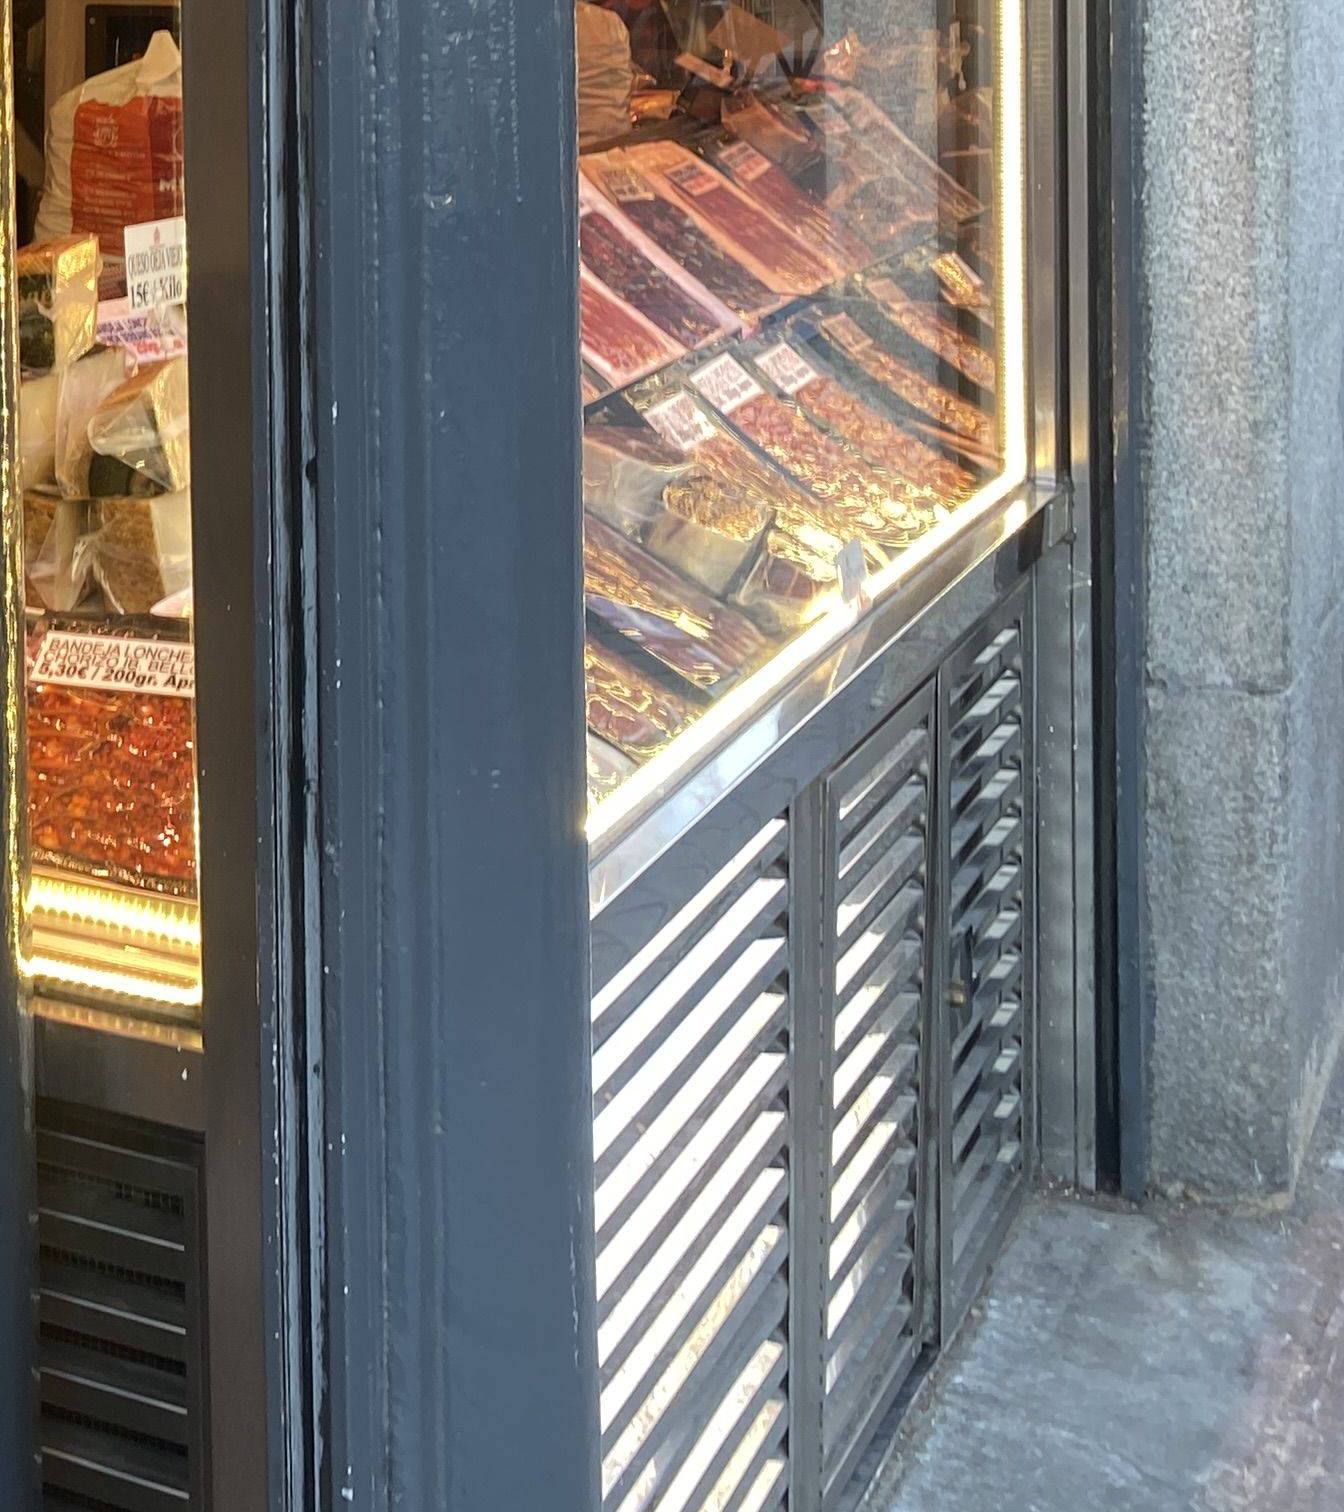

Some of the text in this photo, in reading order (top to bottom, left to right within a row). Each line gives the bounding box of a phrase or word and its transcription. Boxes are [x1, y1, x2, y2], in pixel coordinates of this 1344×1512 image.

[131, 280, 149, 309] 15€
[160, 274, 183, 301] Kilo
[43, 649, 119, 669] CHORIZO
[48, 638, 193, 663] BANDEJA LONCHE
[102, 669, 158, 688] 200gr.
